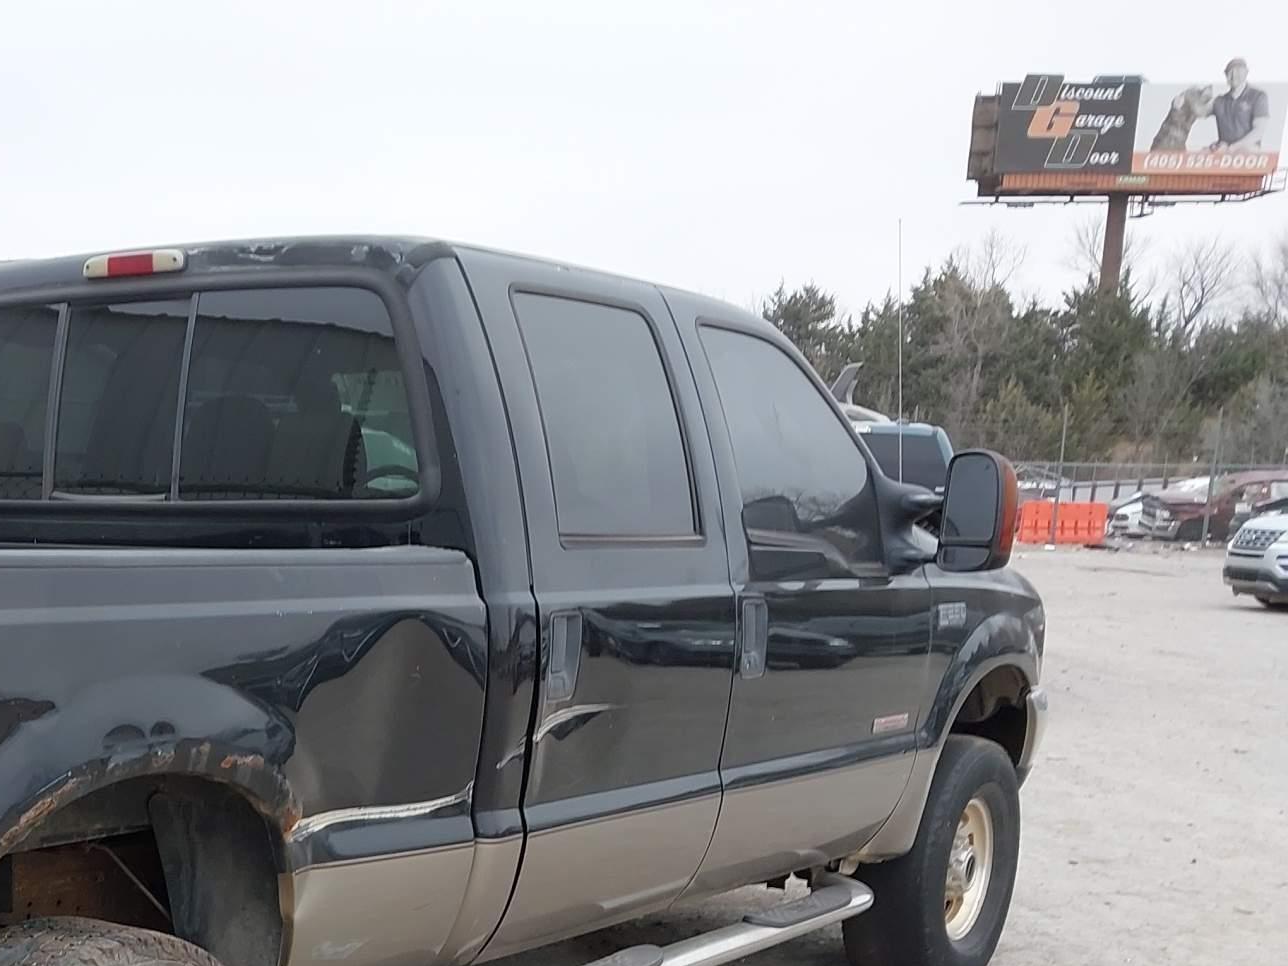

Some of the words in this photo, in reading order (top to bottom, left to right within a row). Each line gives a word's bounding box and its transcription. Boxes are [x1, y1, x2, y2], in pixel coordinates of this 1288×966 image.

[1011, 72, 1125, 110] Discount
[1027, 100, 1125, 138] Garage
[1044, 129, 1119, 168] Door
